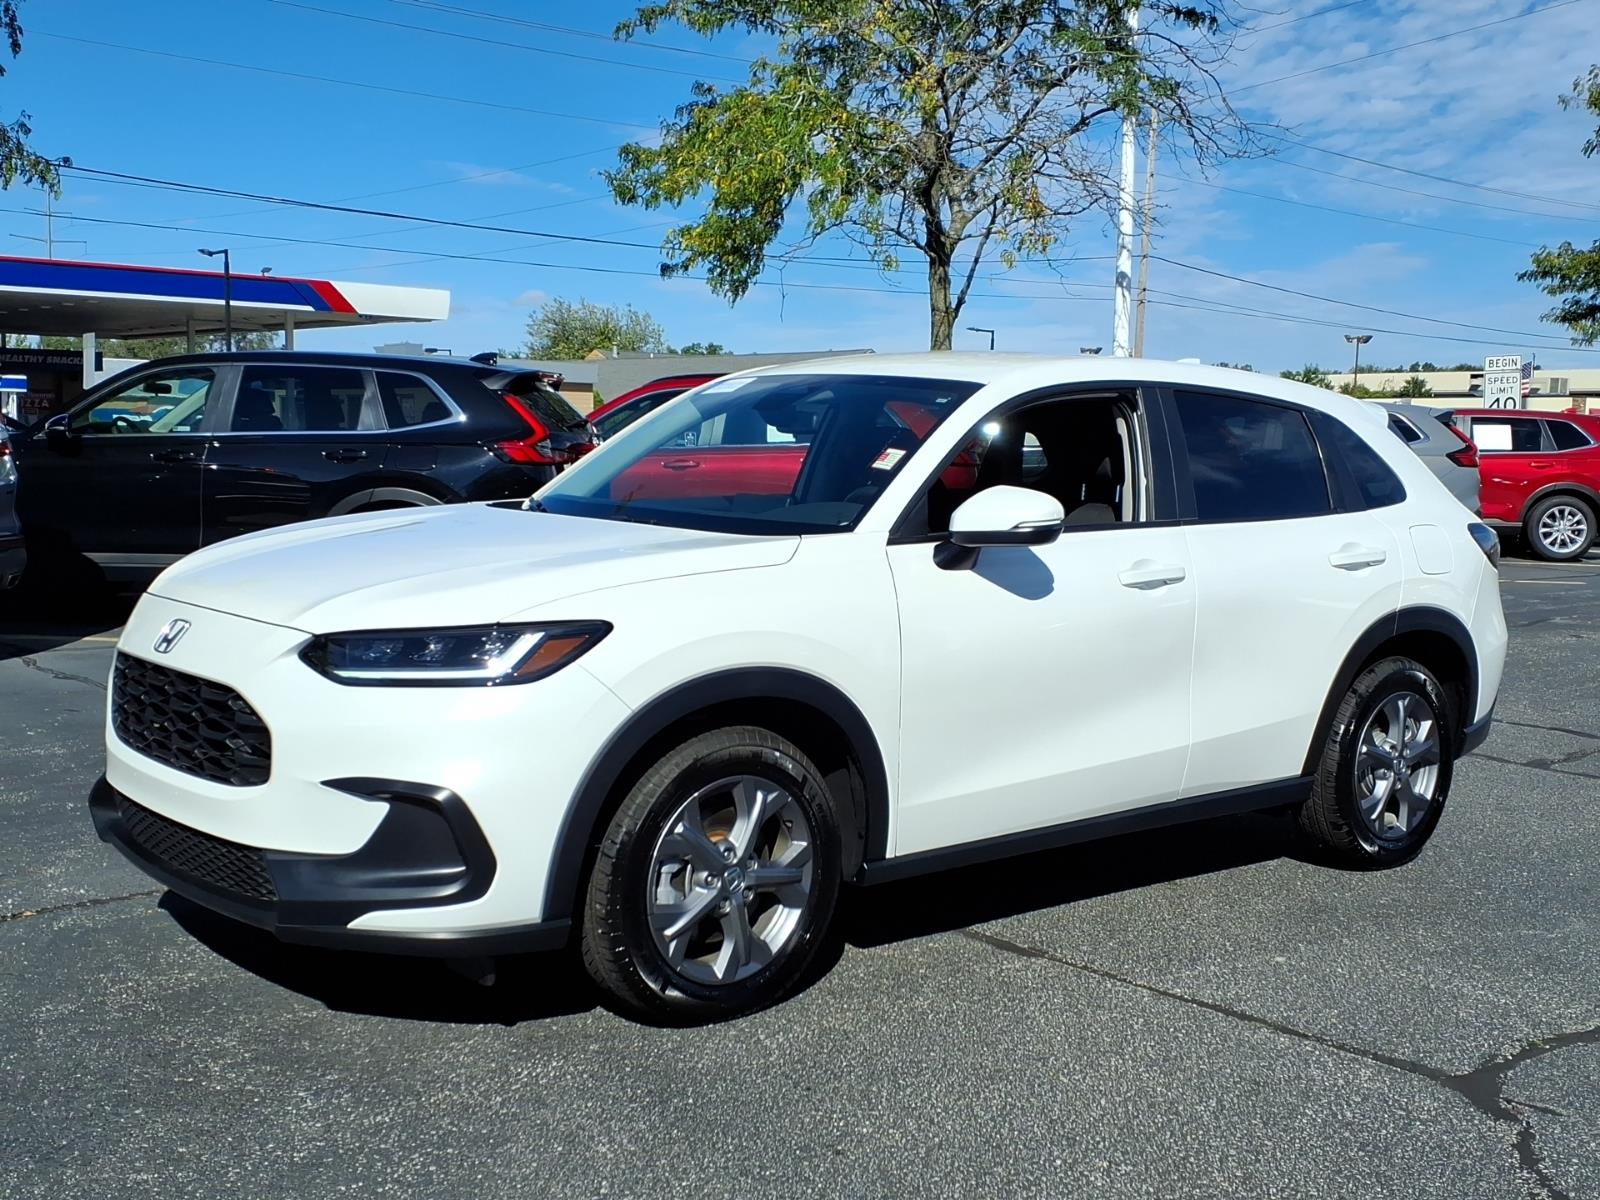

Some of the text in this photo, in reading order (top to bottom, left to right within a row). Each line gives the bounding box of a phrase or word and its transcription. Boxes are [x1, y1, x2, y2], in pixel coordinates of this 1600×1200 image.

[1488, 358, 1518, 368] BEGIN
[1488, 376, 1518, 384] SPEED
[1491, 387, 1514, 395] LIMIT
[1488, 396, 1517, 409] 40
